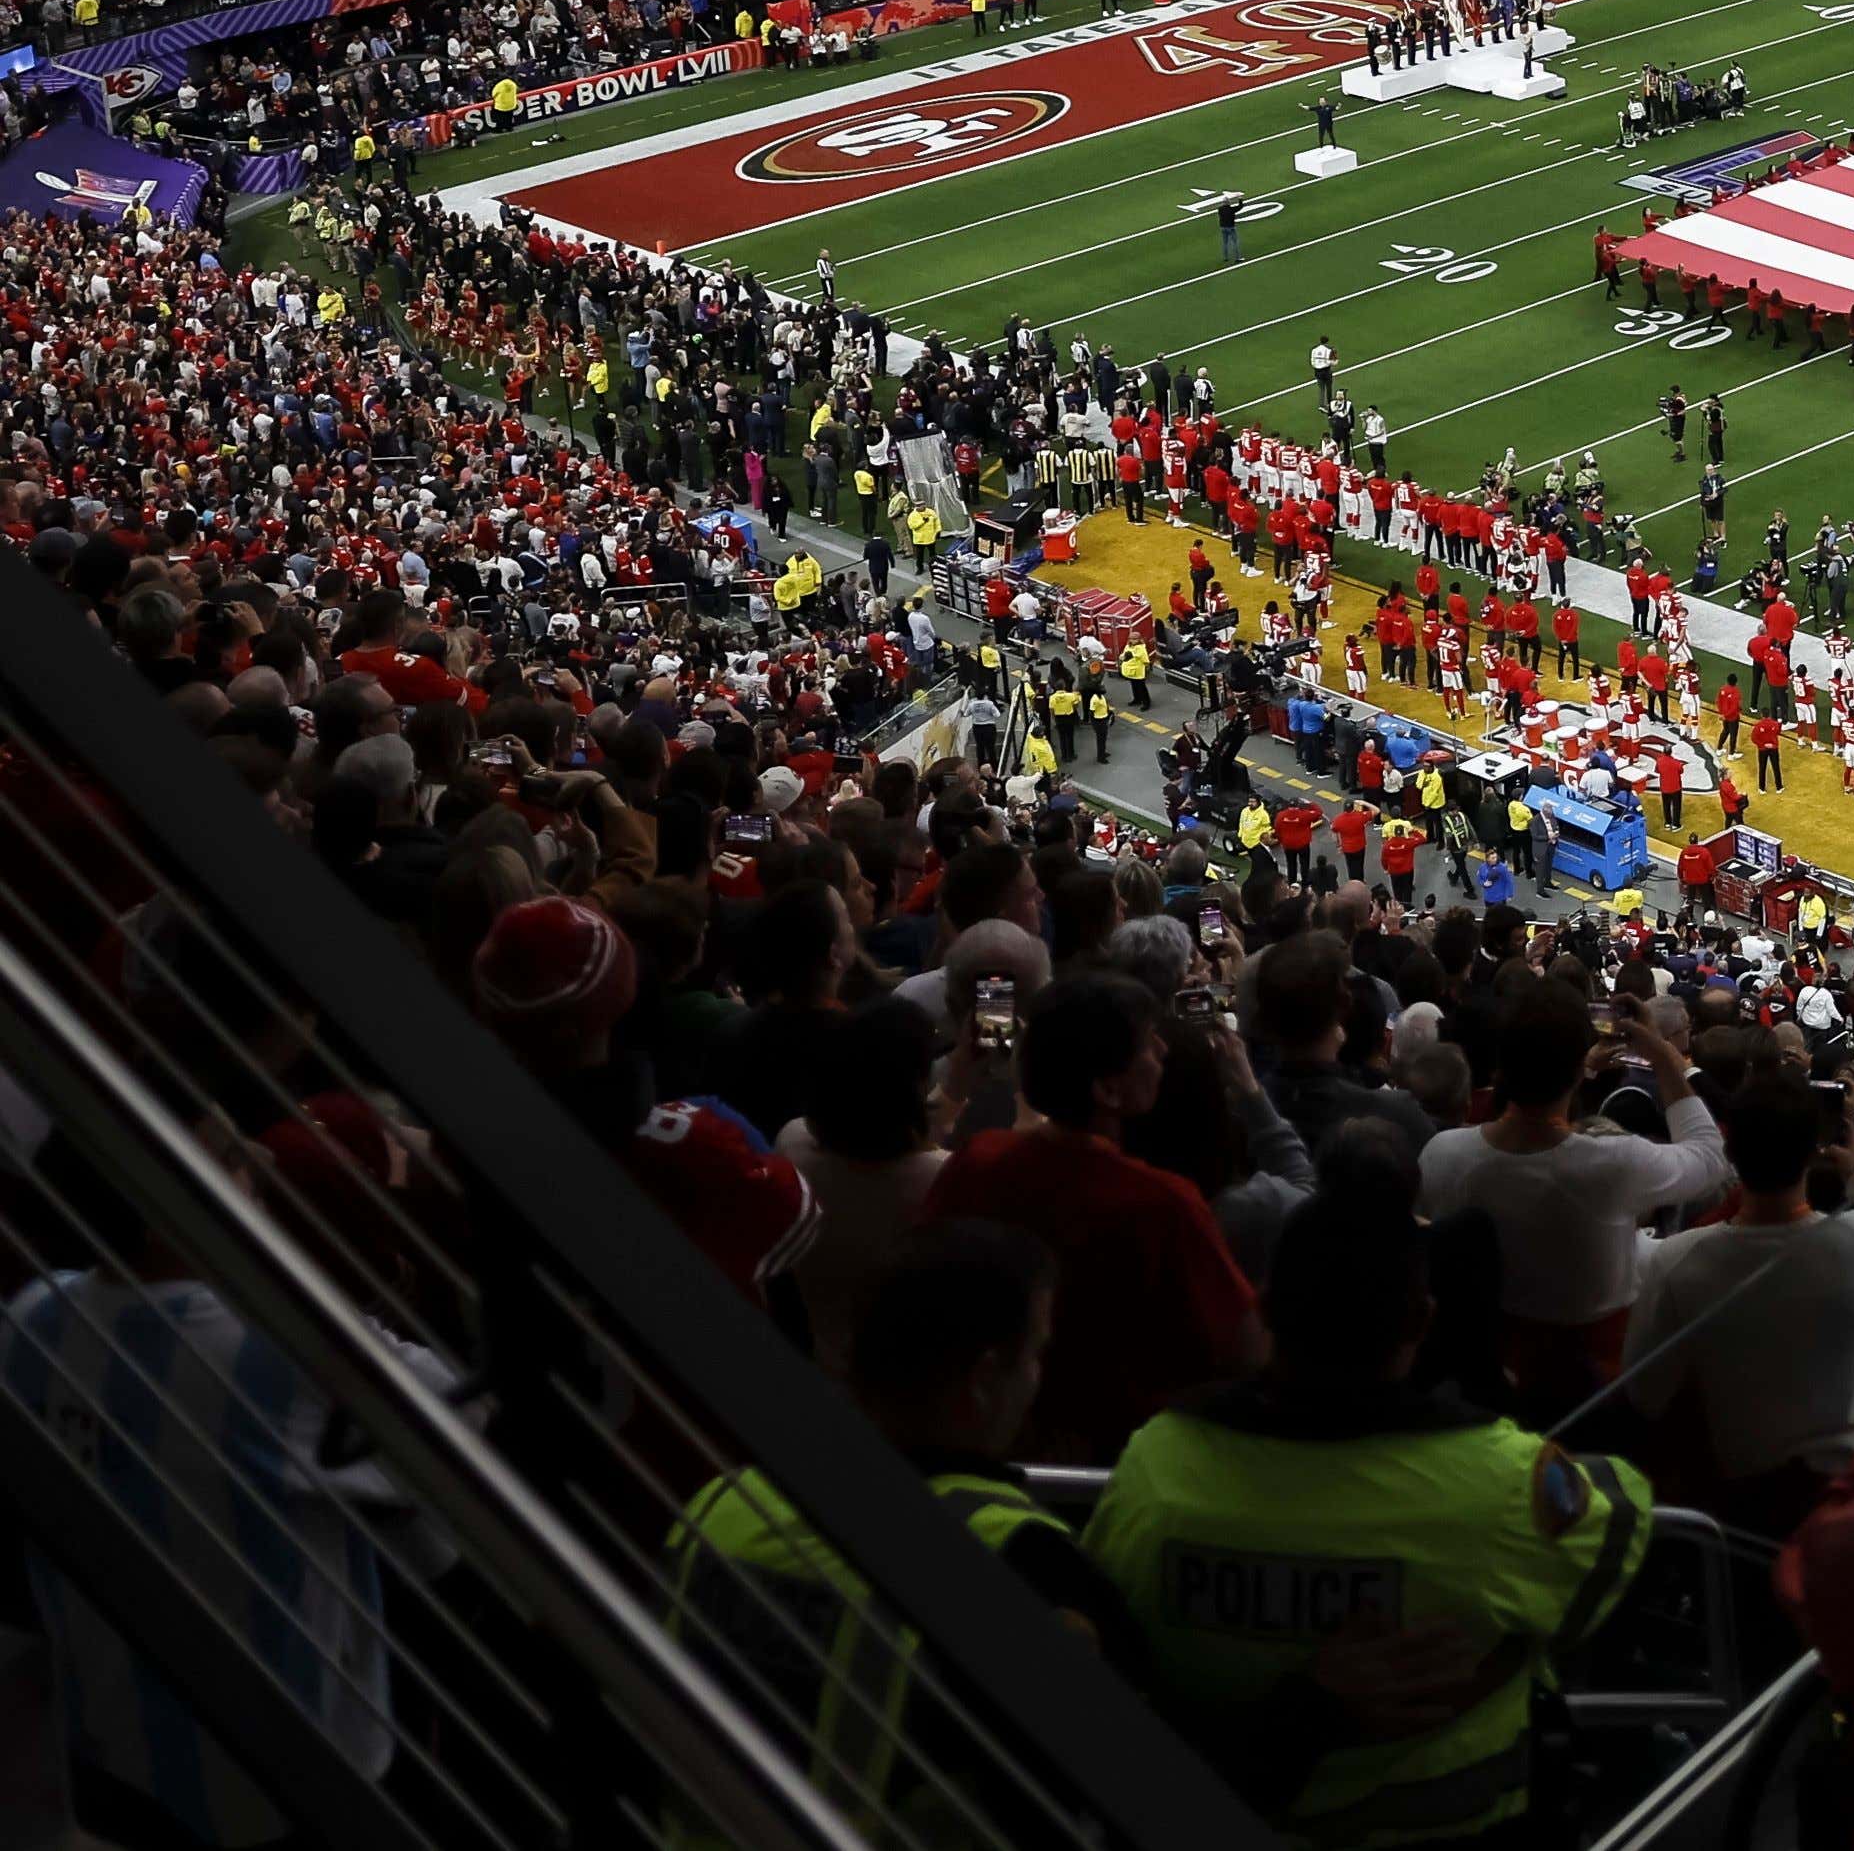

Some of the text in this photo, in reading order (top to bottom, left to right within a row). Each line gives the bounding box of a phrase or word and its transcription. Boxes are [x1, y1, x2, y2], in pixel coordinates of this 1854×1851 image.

[909, 62, 967, 80] IT
[1000, 11, 1168, 60] TAKES
[576, 66, 668, 107] BOWL
[677, 48, 731, 83] LVIII
[1380, 246, 1498, 284] 20
[1615, 308, 1733, 350] 30
[1829, 643, 1845, 657] 12
[1178, 1555, 1382, 1633] POLICE
